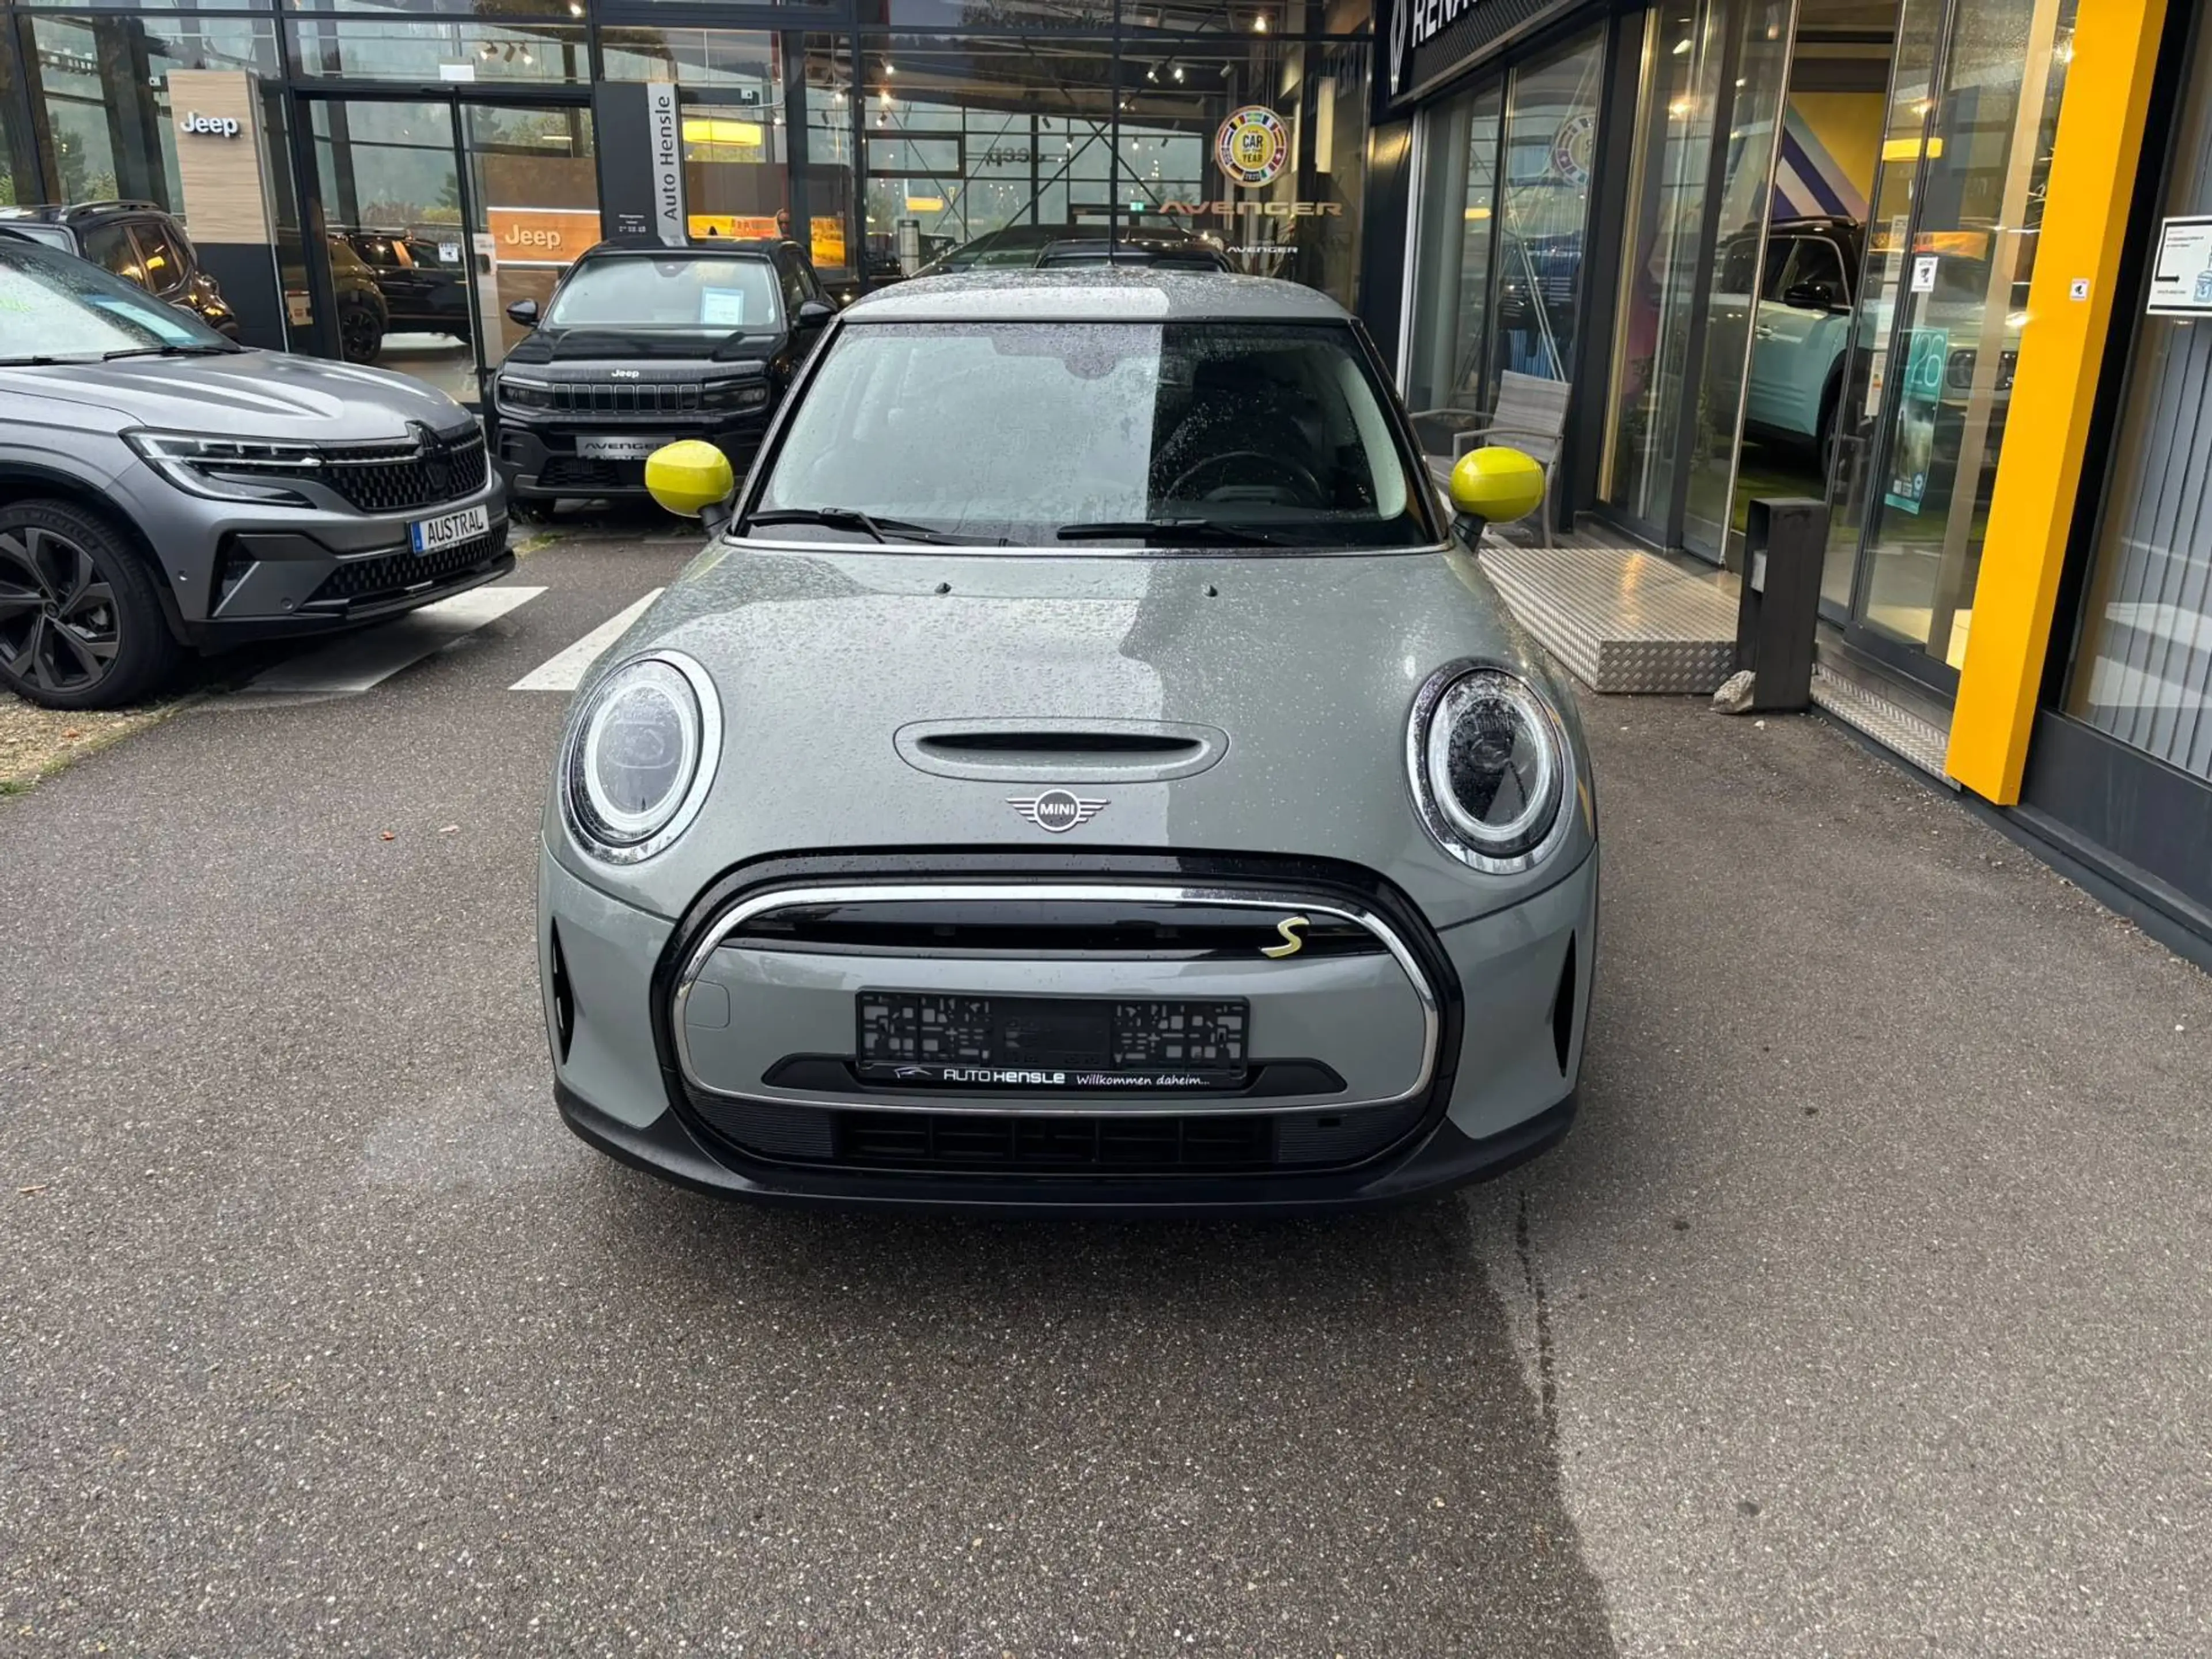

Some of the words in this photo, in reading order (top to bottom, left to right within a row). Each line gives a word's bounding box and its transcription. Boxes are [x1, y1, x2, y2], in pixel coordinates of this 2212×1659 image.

[180, 111, 237, 137] Jeep
[655, 95, 675, 166] Hensle
[1243, 134, 1264, 148] CAR
[1242, 154, 1263, 162] YEAR
[663, 173, 677, 221] Auto
[1159, 201, 1343, 215] AVENGER
[505, 224, 561, 249] Jeep
[611, 369, 639, 378] Jeep
[428, 509, 484, 546] AUSTRAL
[1040, 803, 1075, 816] MINI
[1260, 916, 1309, 959] S
[943, 1069, 990, 1082] AUTO
[1076, 1073, 1153, 1085] Willkommen
